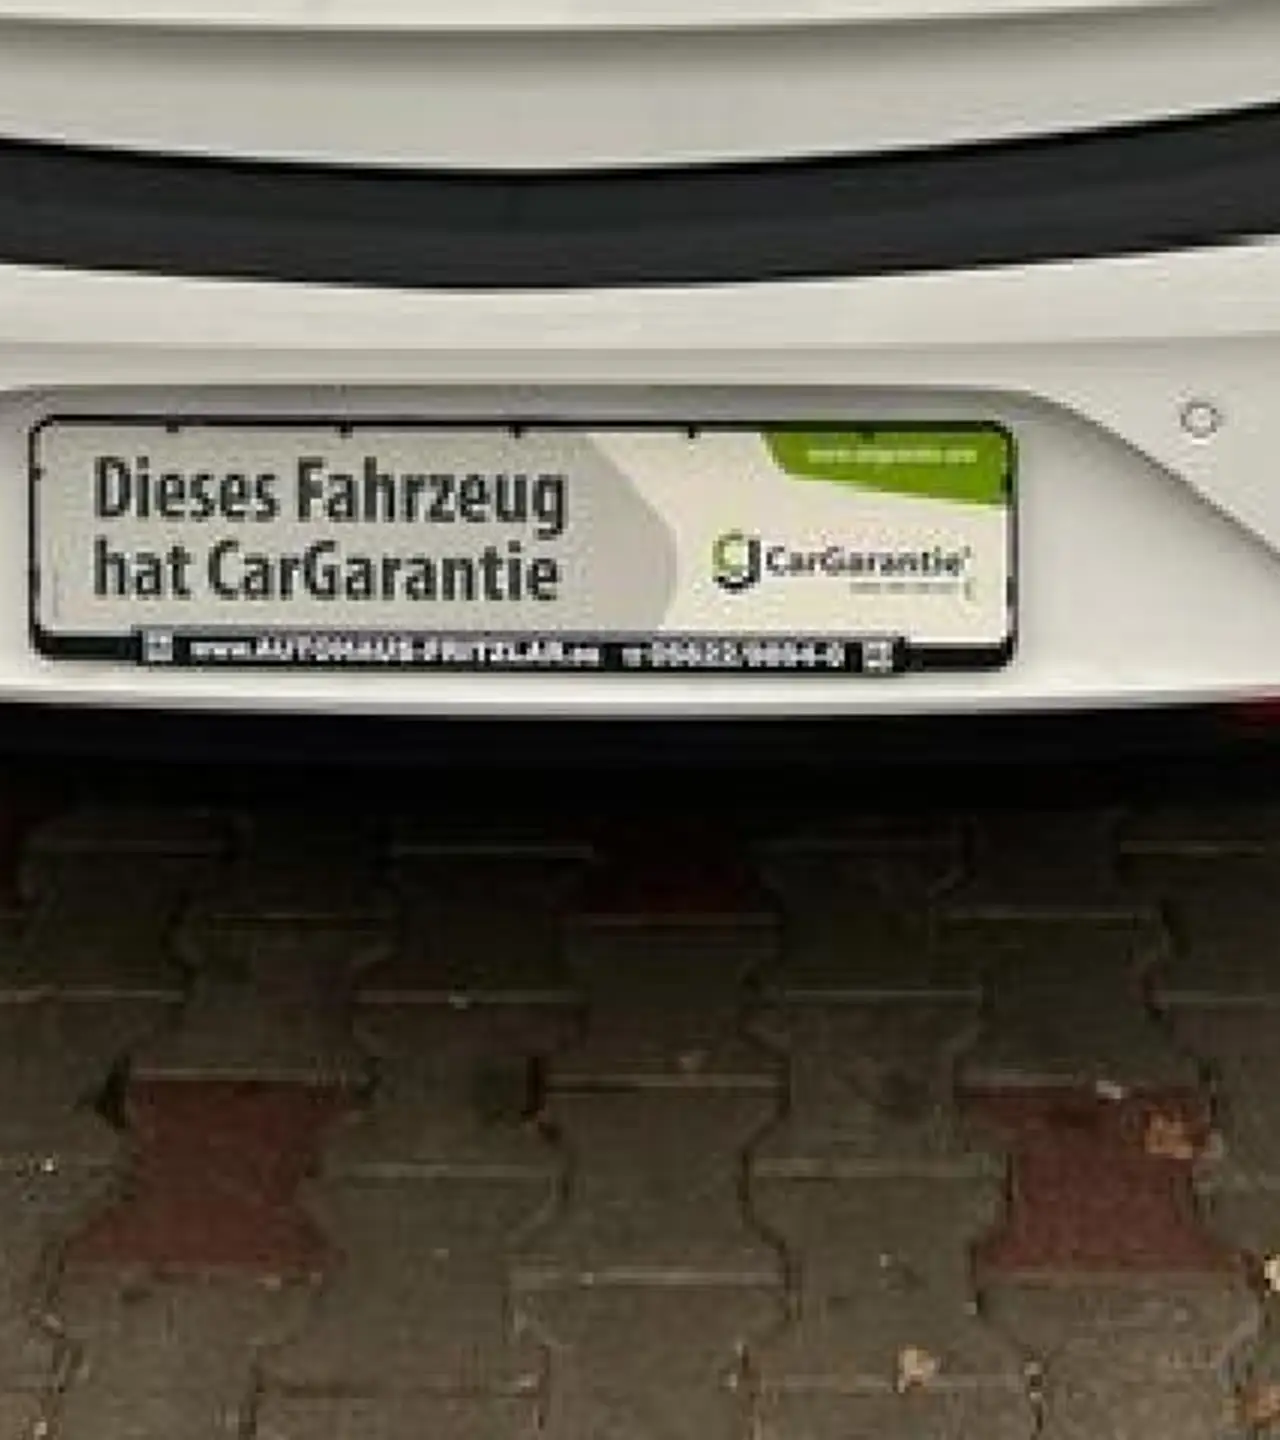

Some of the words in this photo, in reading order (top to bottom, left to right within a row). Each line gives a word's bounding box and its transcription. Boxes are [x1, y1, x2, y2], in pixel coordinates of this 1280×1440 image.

[94, 455, 280, 523] Dieses
[297, 455, 569, 541] Fahrzeug
[94, 534, 193, 601] hat
[207, 539, 562, 601] CarGarantie
[765, 545, 963, 577] CarGarantie
